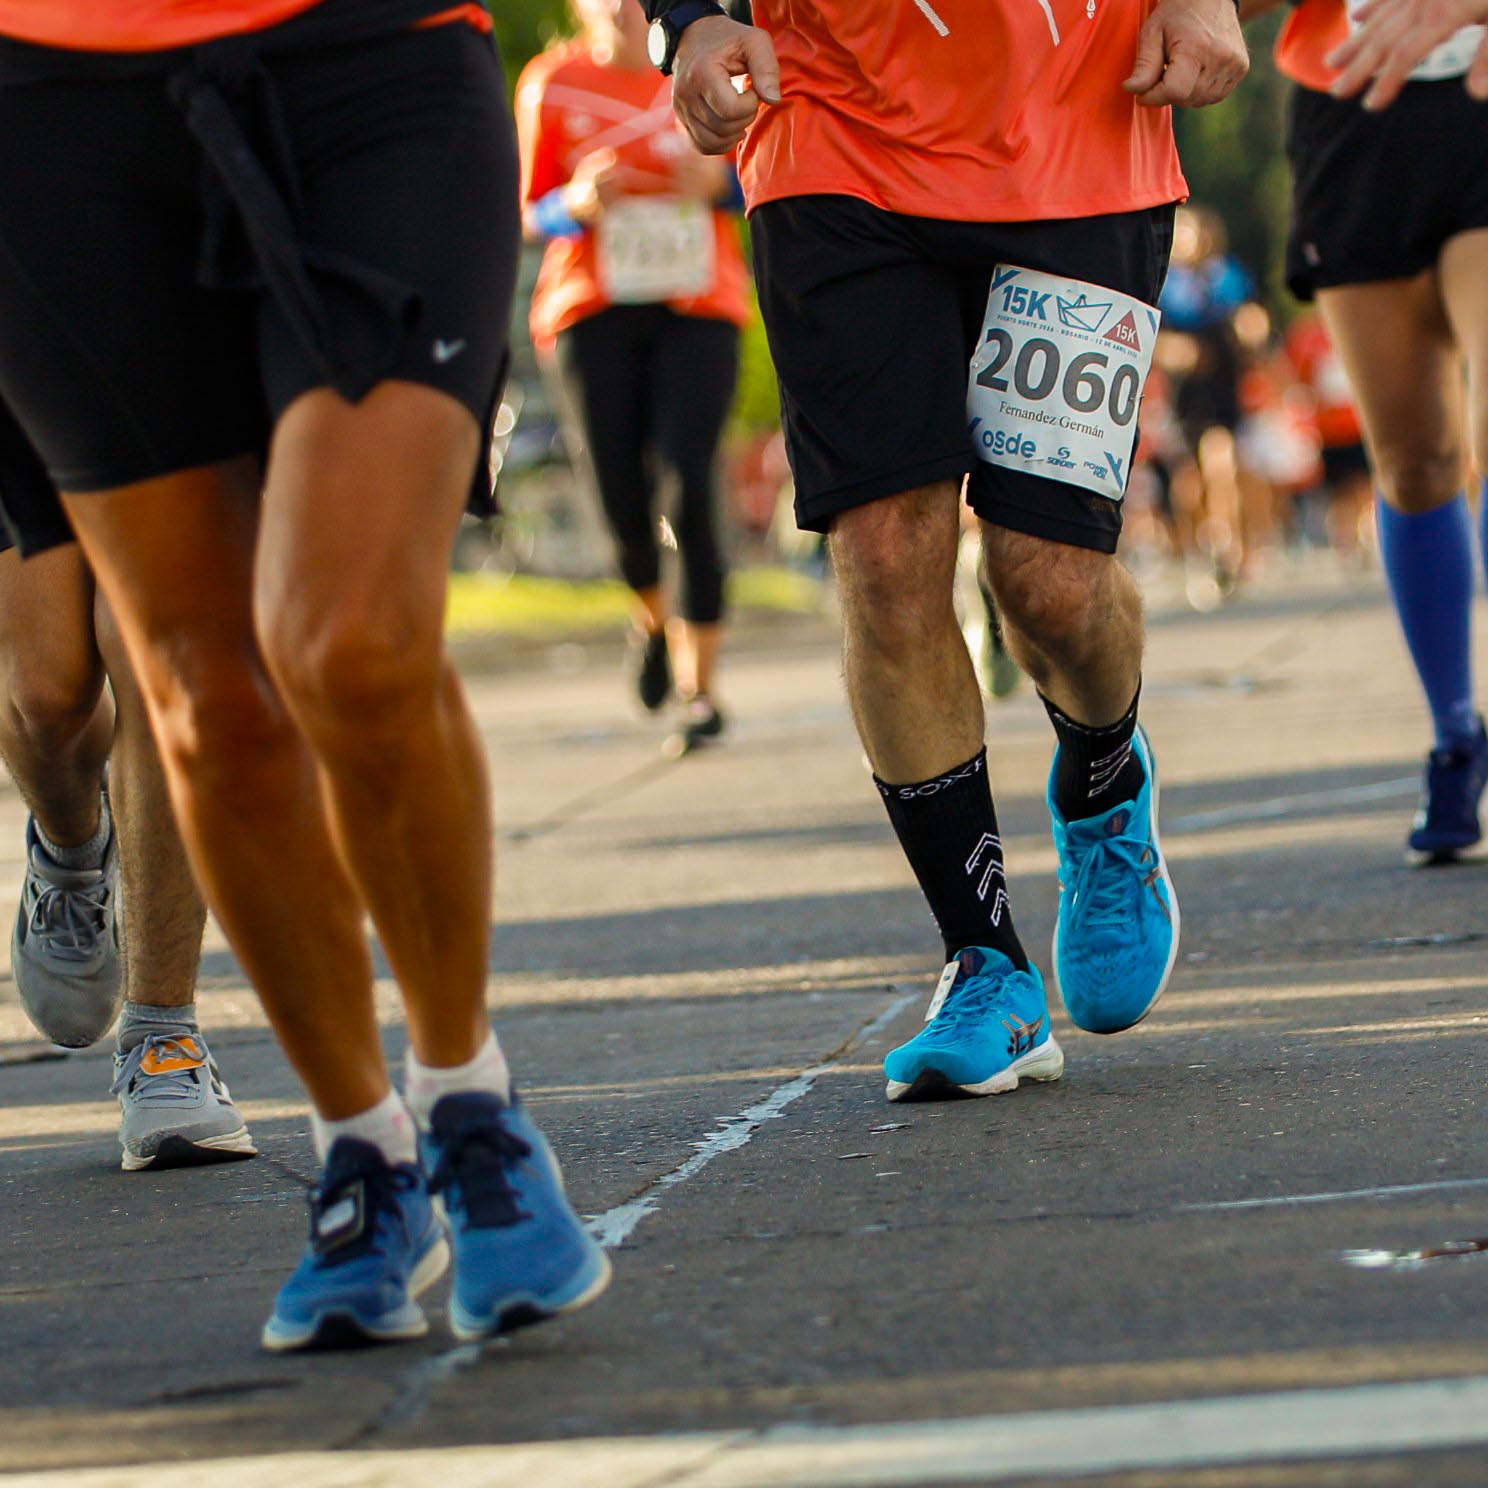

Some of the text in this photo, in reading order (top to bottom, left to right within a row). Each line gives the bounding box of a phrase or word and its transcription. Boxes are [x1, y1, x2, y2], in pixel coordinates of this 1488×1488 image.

[1002, 284, 1053, 321] 15K
[1115, 323, 1137, 344] 15K
[976, 328, 1140, 426] 2060
[999, 401, 1105, 439] Fernandez Germán
[982, 430, 1037, 458] osde
